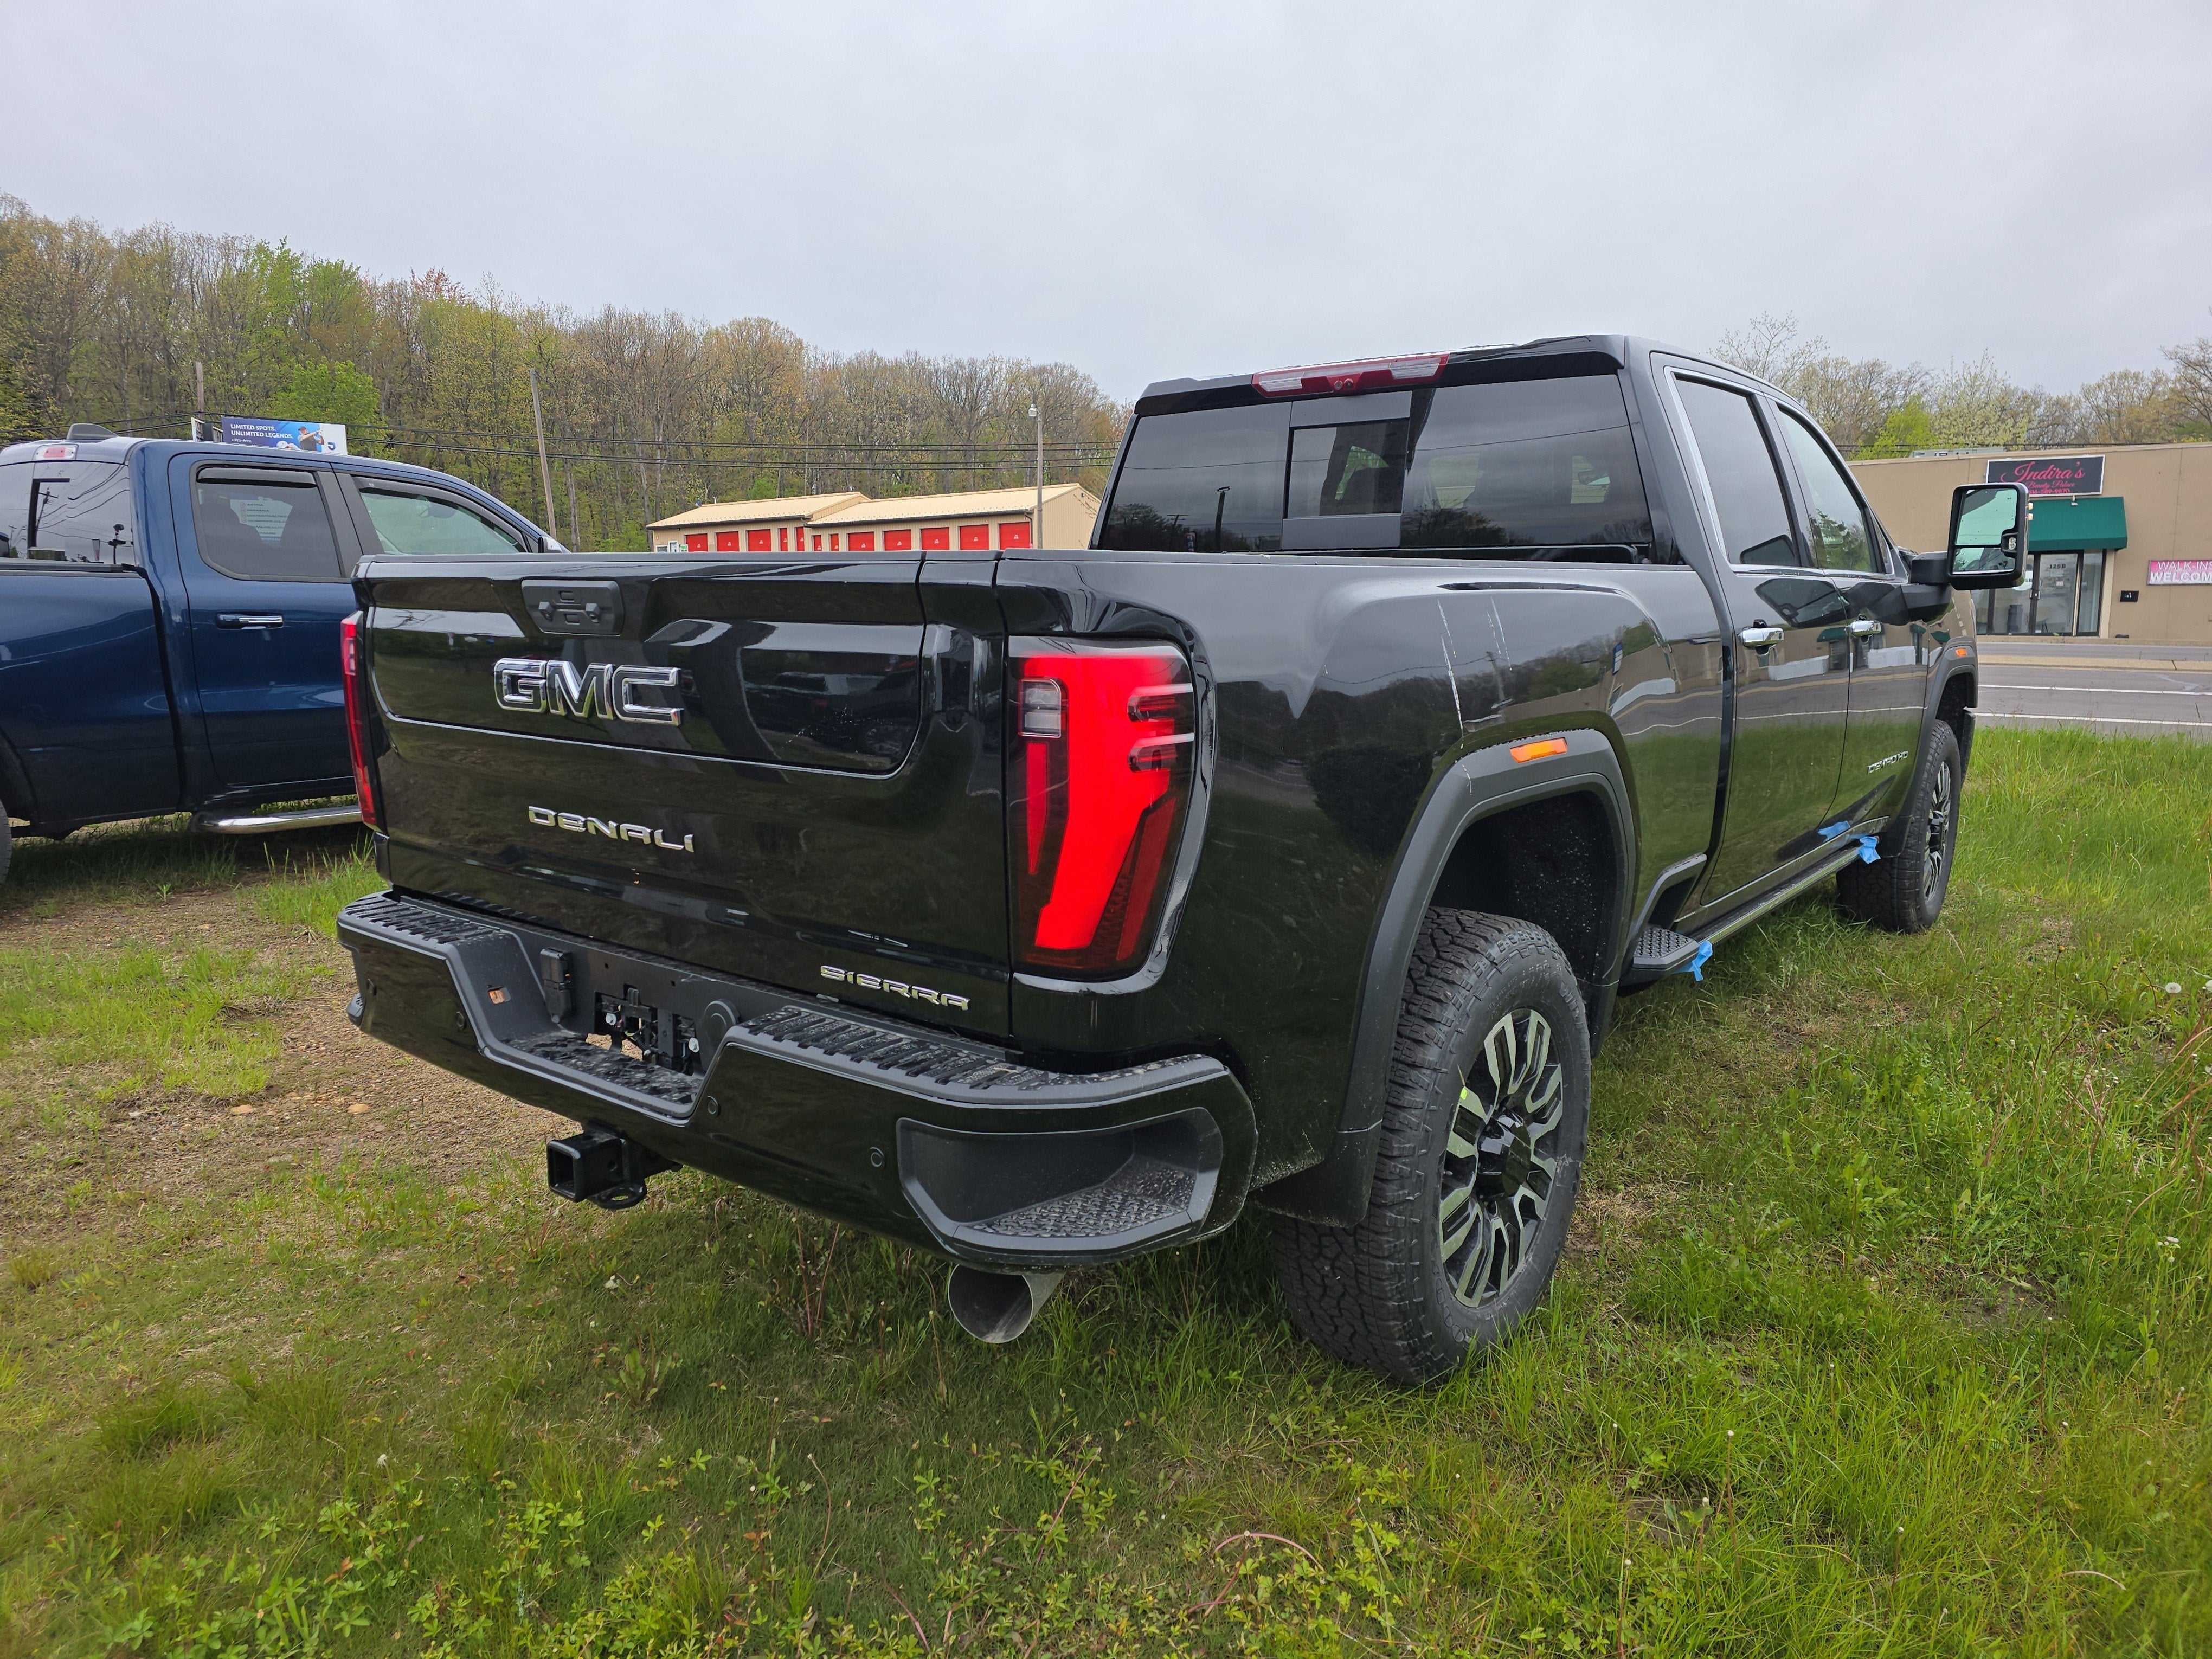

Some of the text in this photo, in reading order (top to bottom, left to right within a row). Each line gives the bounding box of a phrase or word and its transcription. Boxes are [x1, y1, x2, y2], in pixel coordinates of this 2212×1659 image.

[2000, 461, 2085, 483] Indira's
[494, 658, 685, 728] GMC
[528, 806, 695, 853] DENALI
[820, 965, 970, 1011] SIERRA
